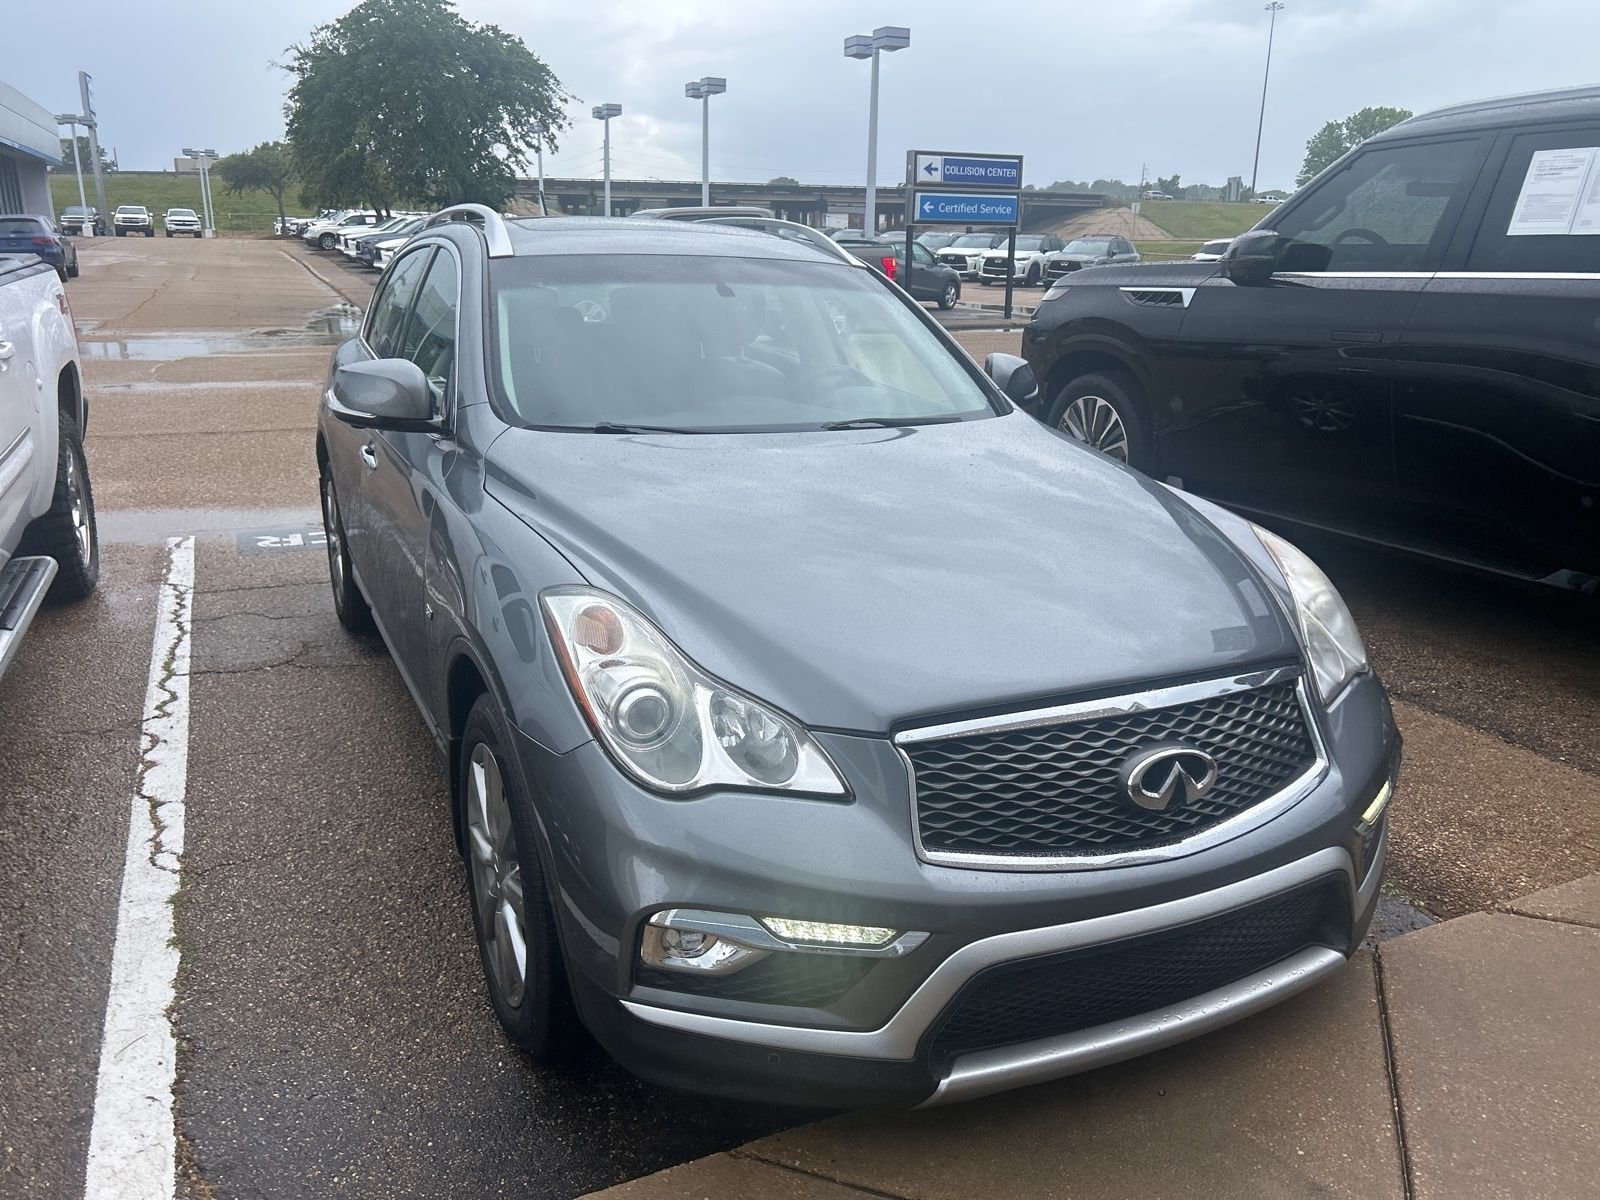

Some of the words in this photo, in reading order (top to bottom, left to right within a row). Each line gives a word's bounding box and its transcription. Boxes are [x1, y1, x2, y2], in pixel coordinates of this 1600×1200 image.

[944, 165, 985, 176] COLLISION
[987, 167, 1017, 178] CENTER
[938, 202, 978, 214] Certified
[980, 204, 1012, 214] Service
